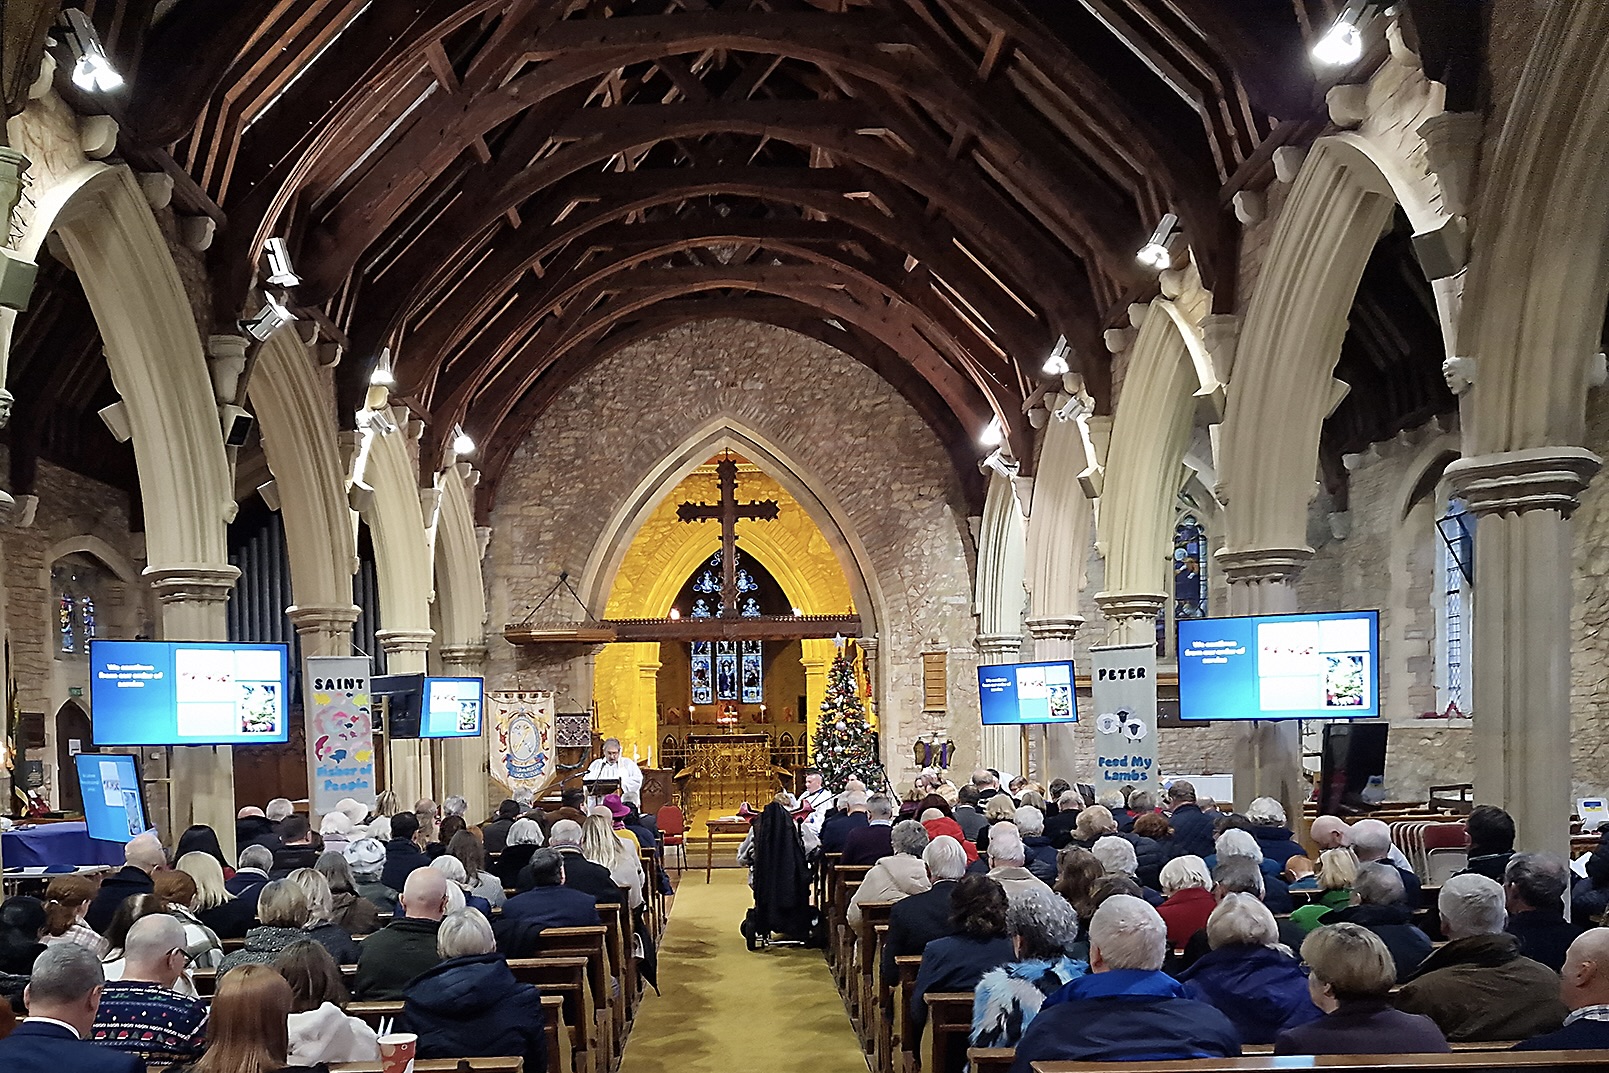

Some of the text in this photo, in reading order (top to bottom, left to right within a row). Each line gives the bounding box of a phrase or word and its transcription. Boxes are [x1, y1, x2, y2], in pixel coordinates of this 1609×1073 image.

[1098, 667, 1146, 681] PETER
[314, 677, 364, 690] SAINT
[360, 763, 373, 775] of
[1098, 755, 1152, 770] Feed My
[1104, 769, 1149, 782] Lambs
[324, 778, 369, 791] People
